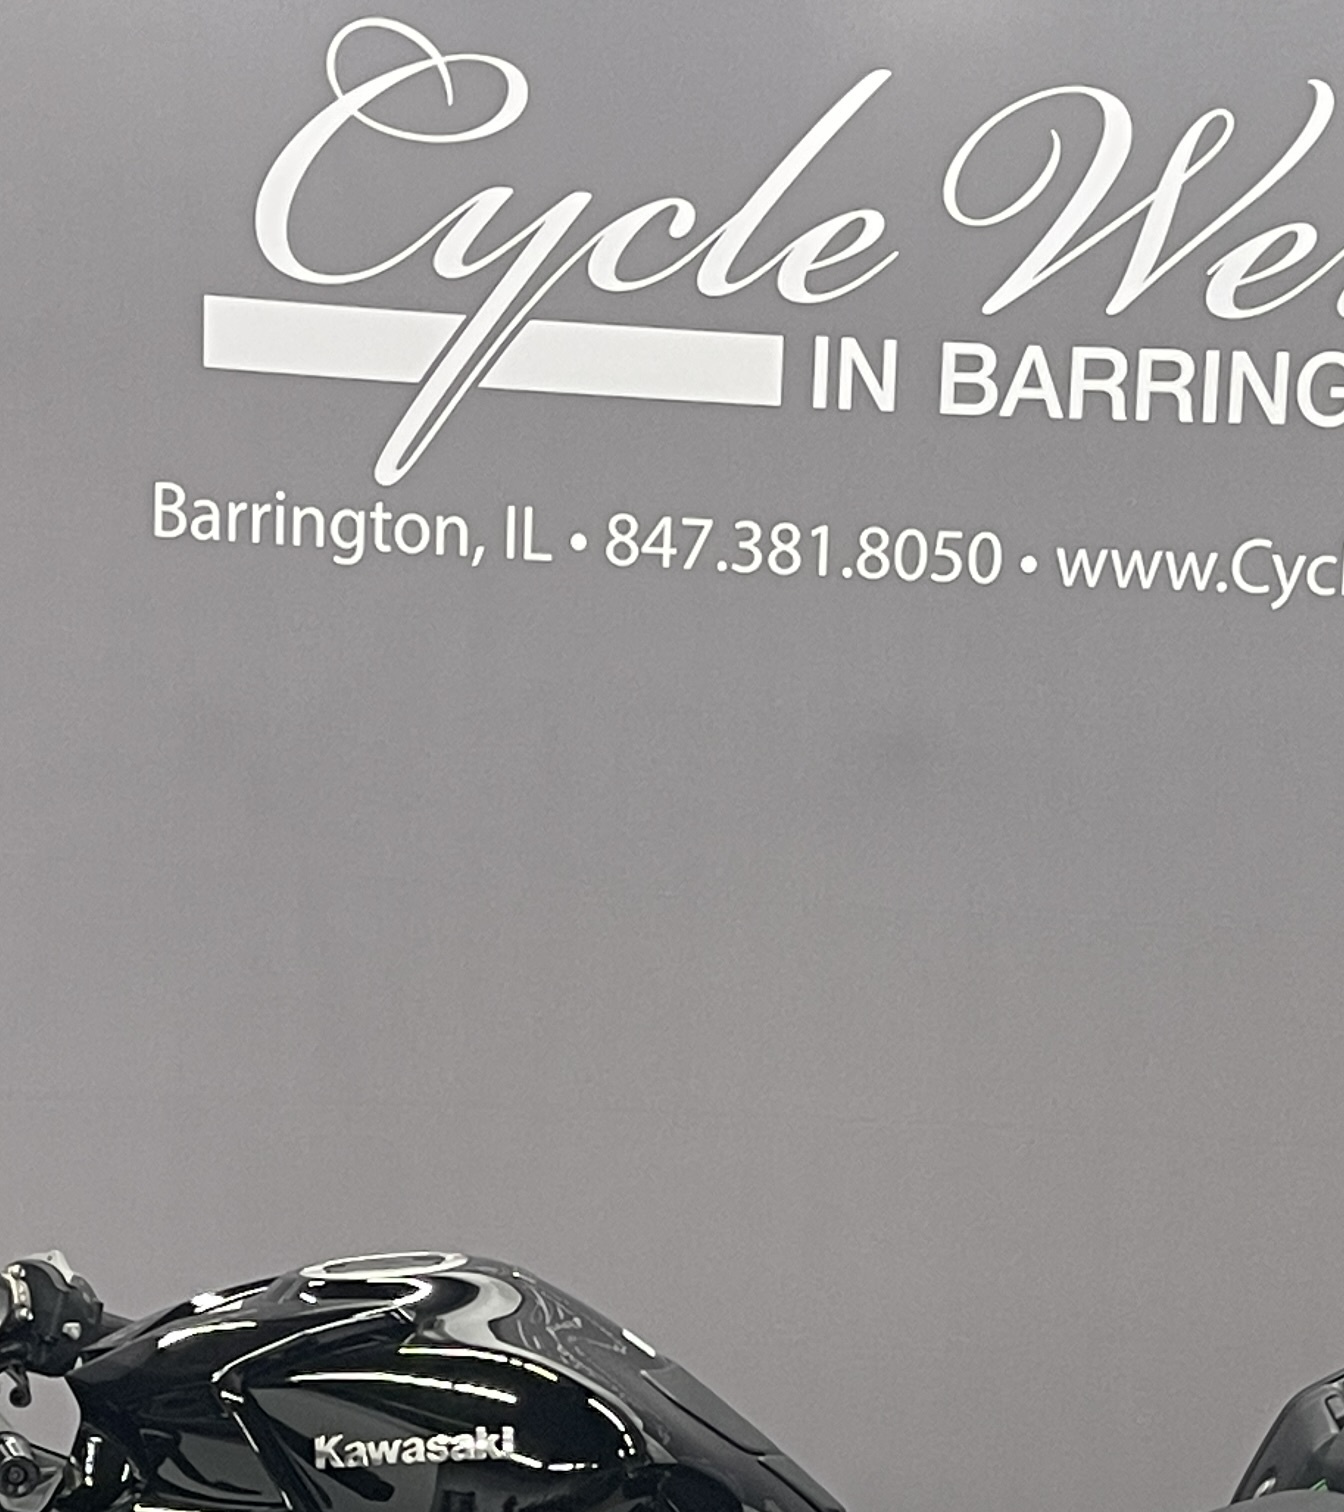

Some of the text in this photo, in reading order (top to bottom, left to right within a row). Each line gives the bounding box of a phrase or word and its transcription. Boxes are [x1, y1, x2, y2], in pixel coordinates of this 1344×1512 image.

[254, 17, 900, 486] Cycle
[812, 335, 898, 412] IN
[154, 481, 485, 567] Barrington,
[506, 505, 553, 562] IL
[605, 513, 1002, 585] 847.381.8050
[313, 1424, 515, 1470] Kawasaki
